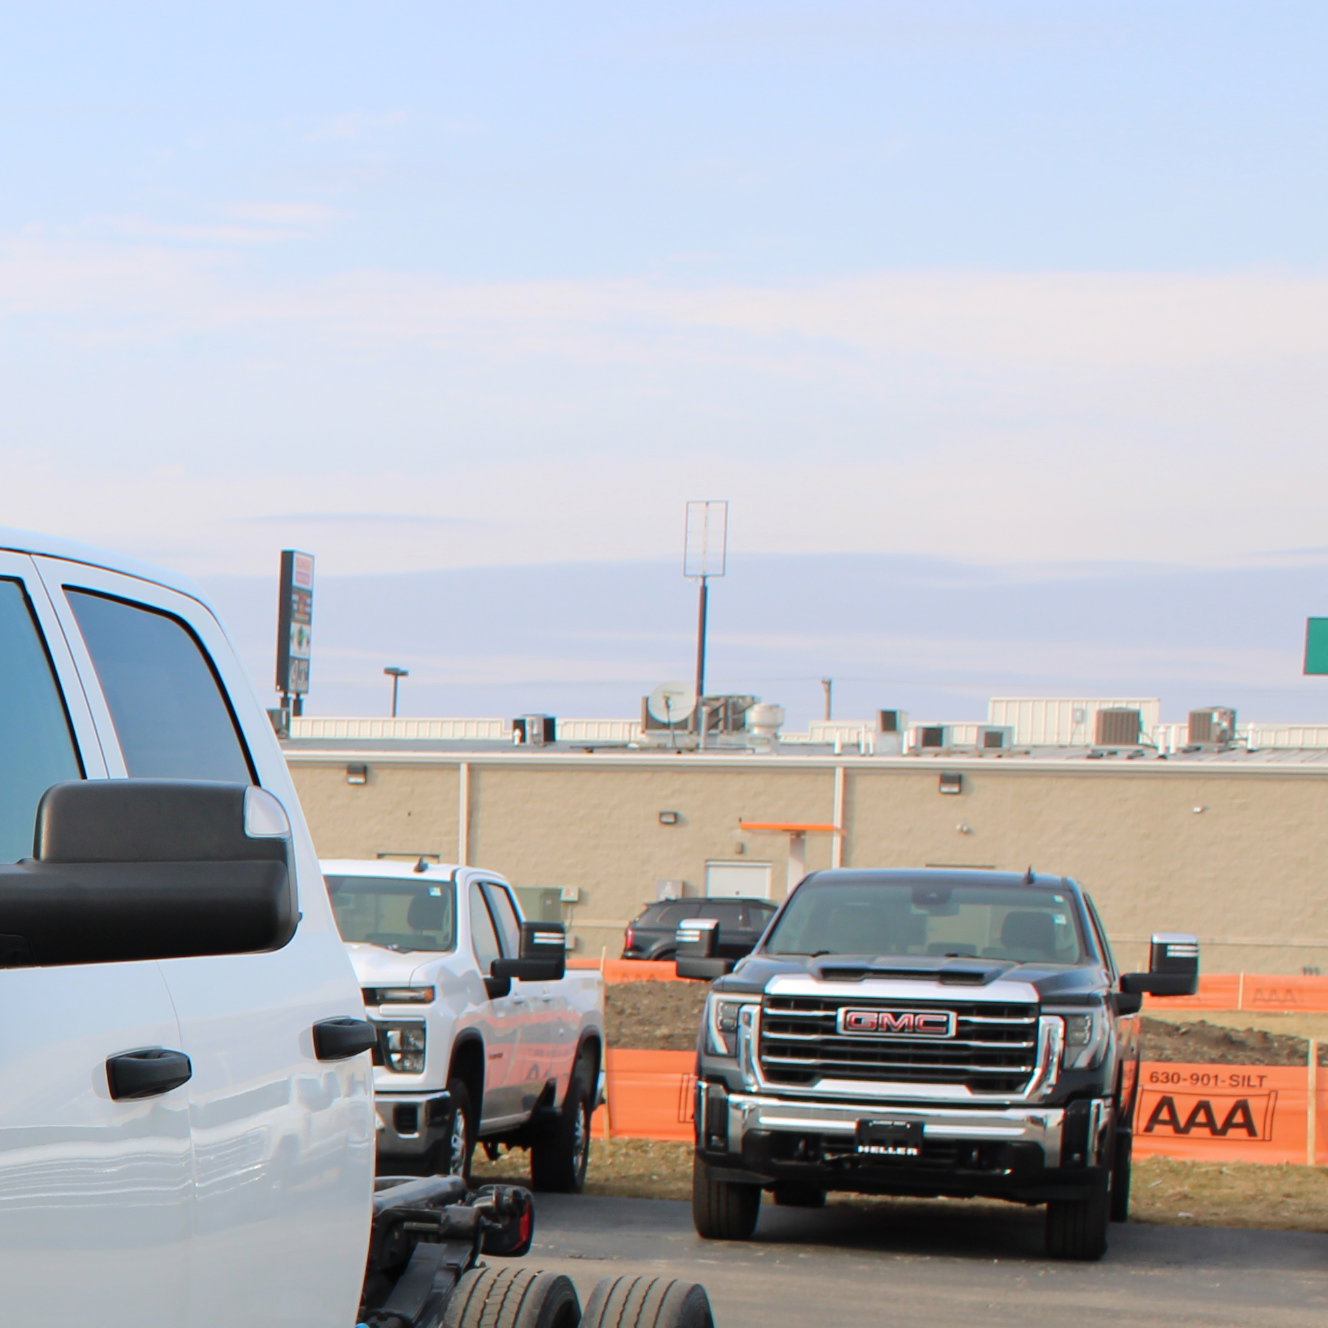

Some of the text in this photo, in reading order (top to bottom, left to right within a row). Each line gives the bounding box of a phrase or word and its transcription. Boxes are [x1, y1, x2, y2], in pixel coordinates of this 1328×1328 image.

[846, 1011, 948, 1033] GMC
[1149, 1071, 1267, 1088] 630-901-SILT
[1143, 1095, 1258, 1137] AAA
[857, 1145, 919, 1156] HELLER
